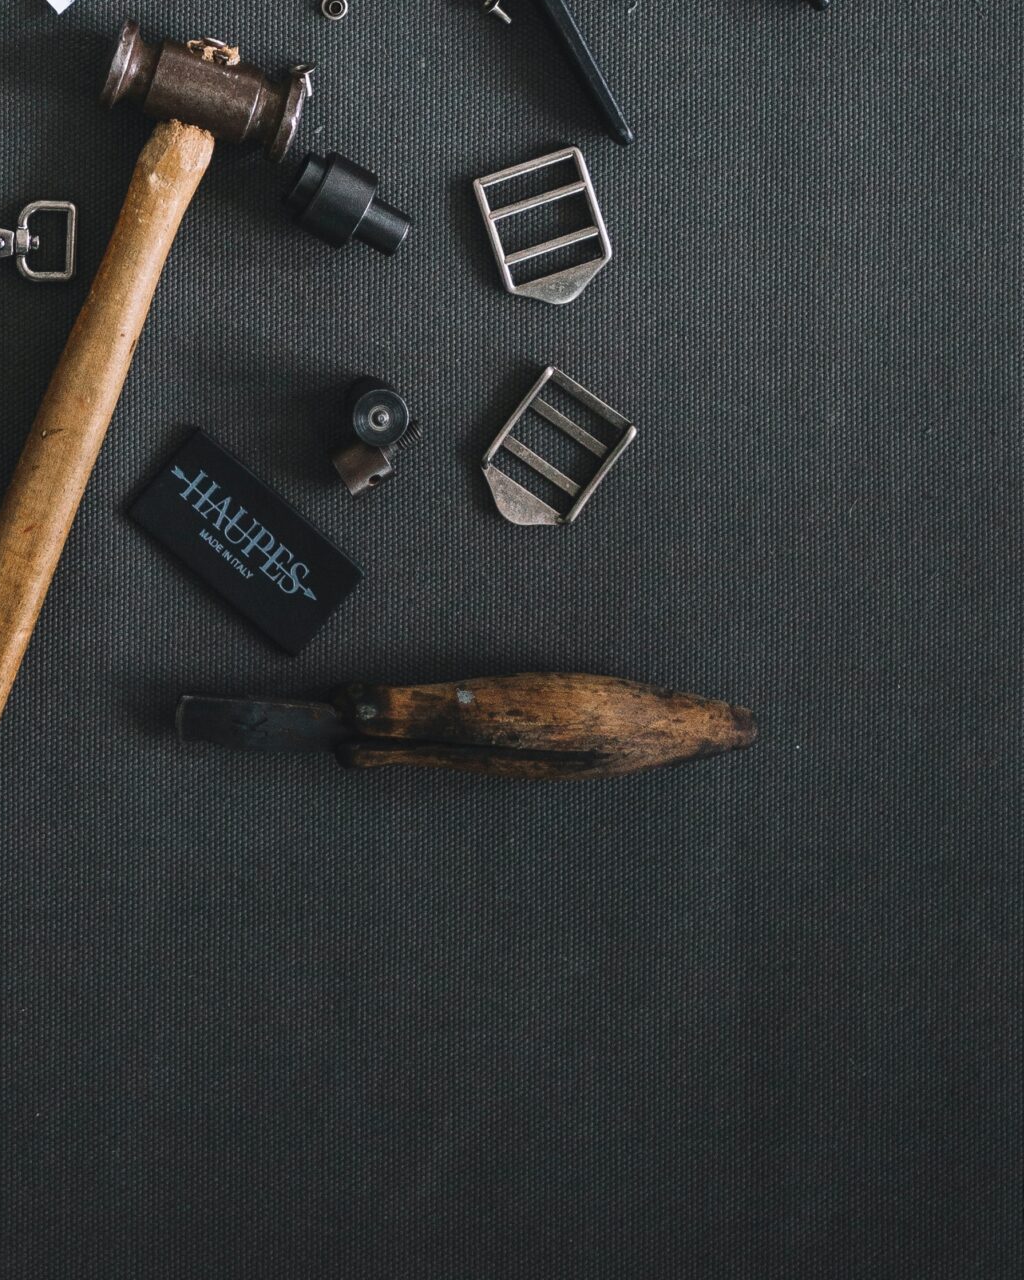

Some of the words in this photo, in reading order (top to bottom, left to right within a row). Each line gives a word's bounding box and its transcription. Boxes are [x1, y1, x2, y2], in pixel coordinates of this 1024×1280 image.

[179, 469, 310, 595] HAUPES
[199, 529, 224, 553] MADE
[221, 550, 233, 561] IN
[230, 557, 254, 579] ITALY
